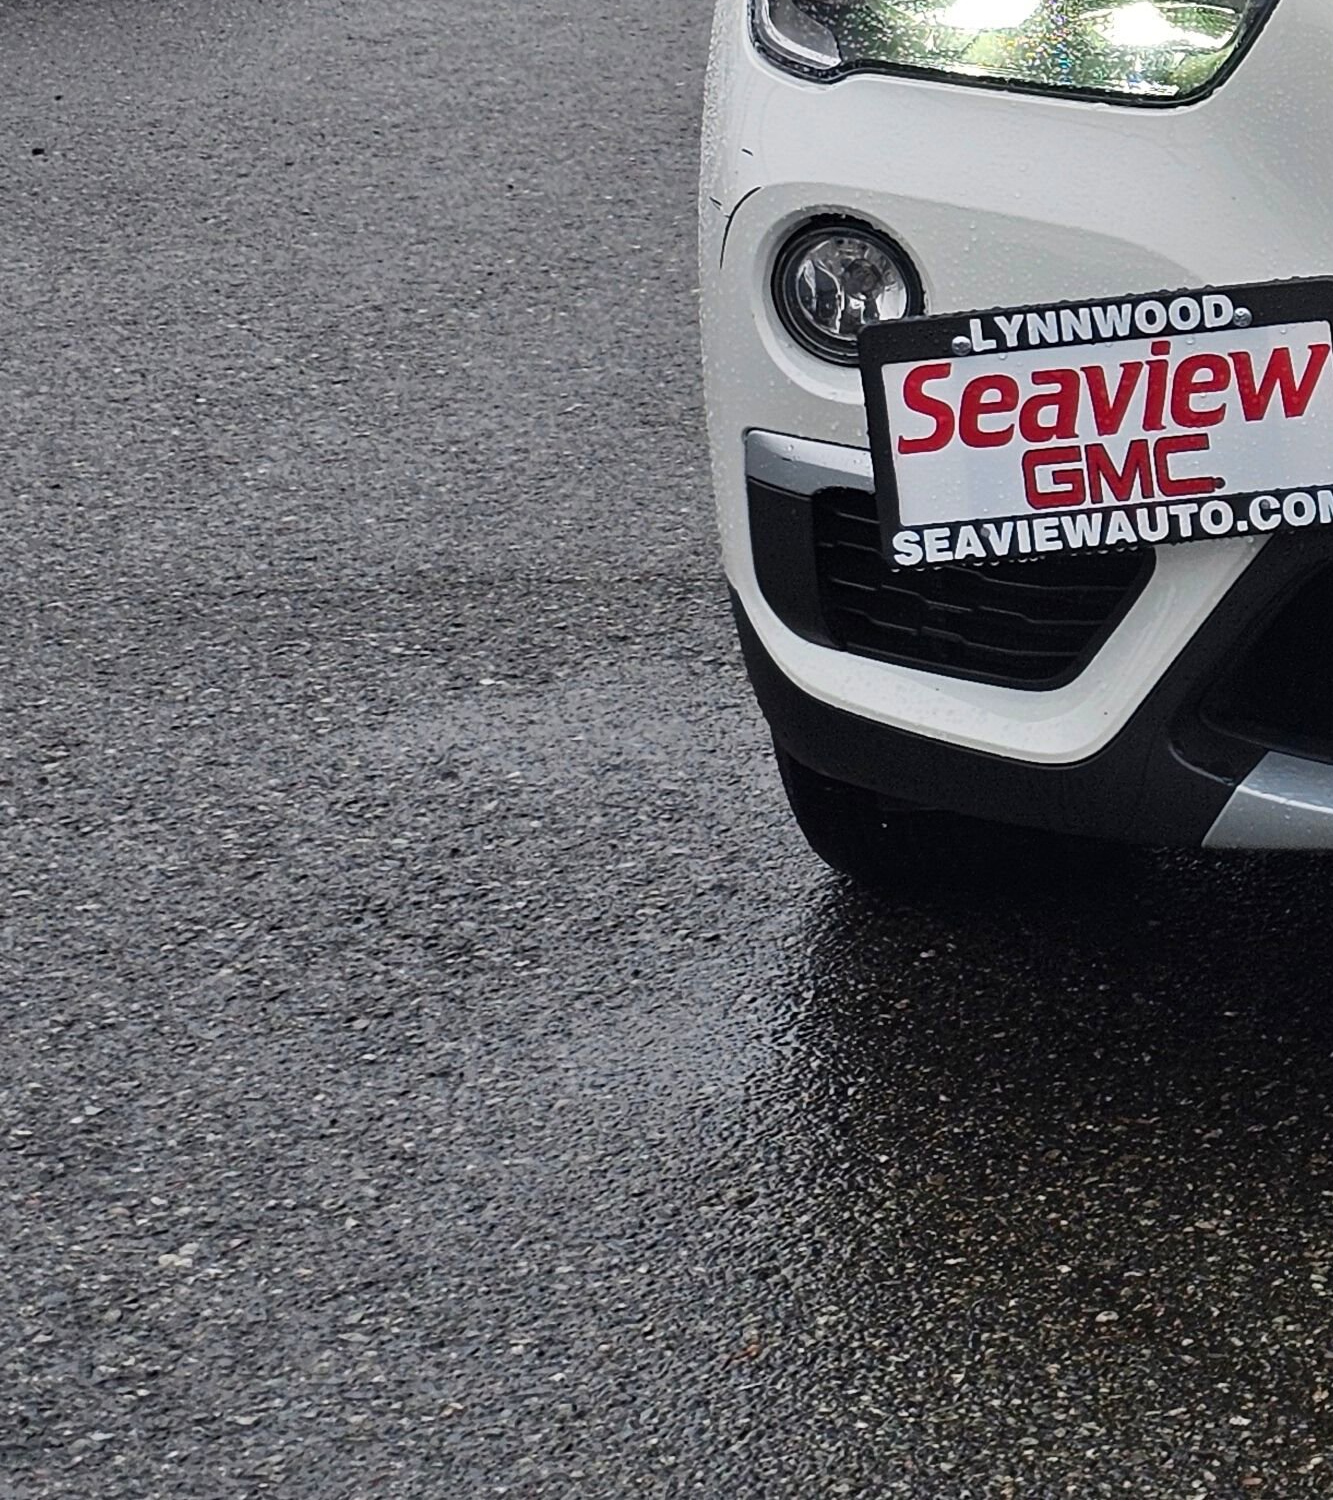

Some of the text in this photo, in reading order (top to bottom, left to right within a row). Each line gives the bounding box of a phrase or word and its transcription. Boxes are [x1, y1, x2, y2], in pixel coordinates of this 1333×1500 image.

[970, 294, 1235, 353] LYNNWOOD
[898, 341, 1330, 455] Seaview
[1021, 434, 1218, 510] GMC
